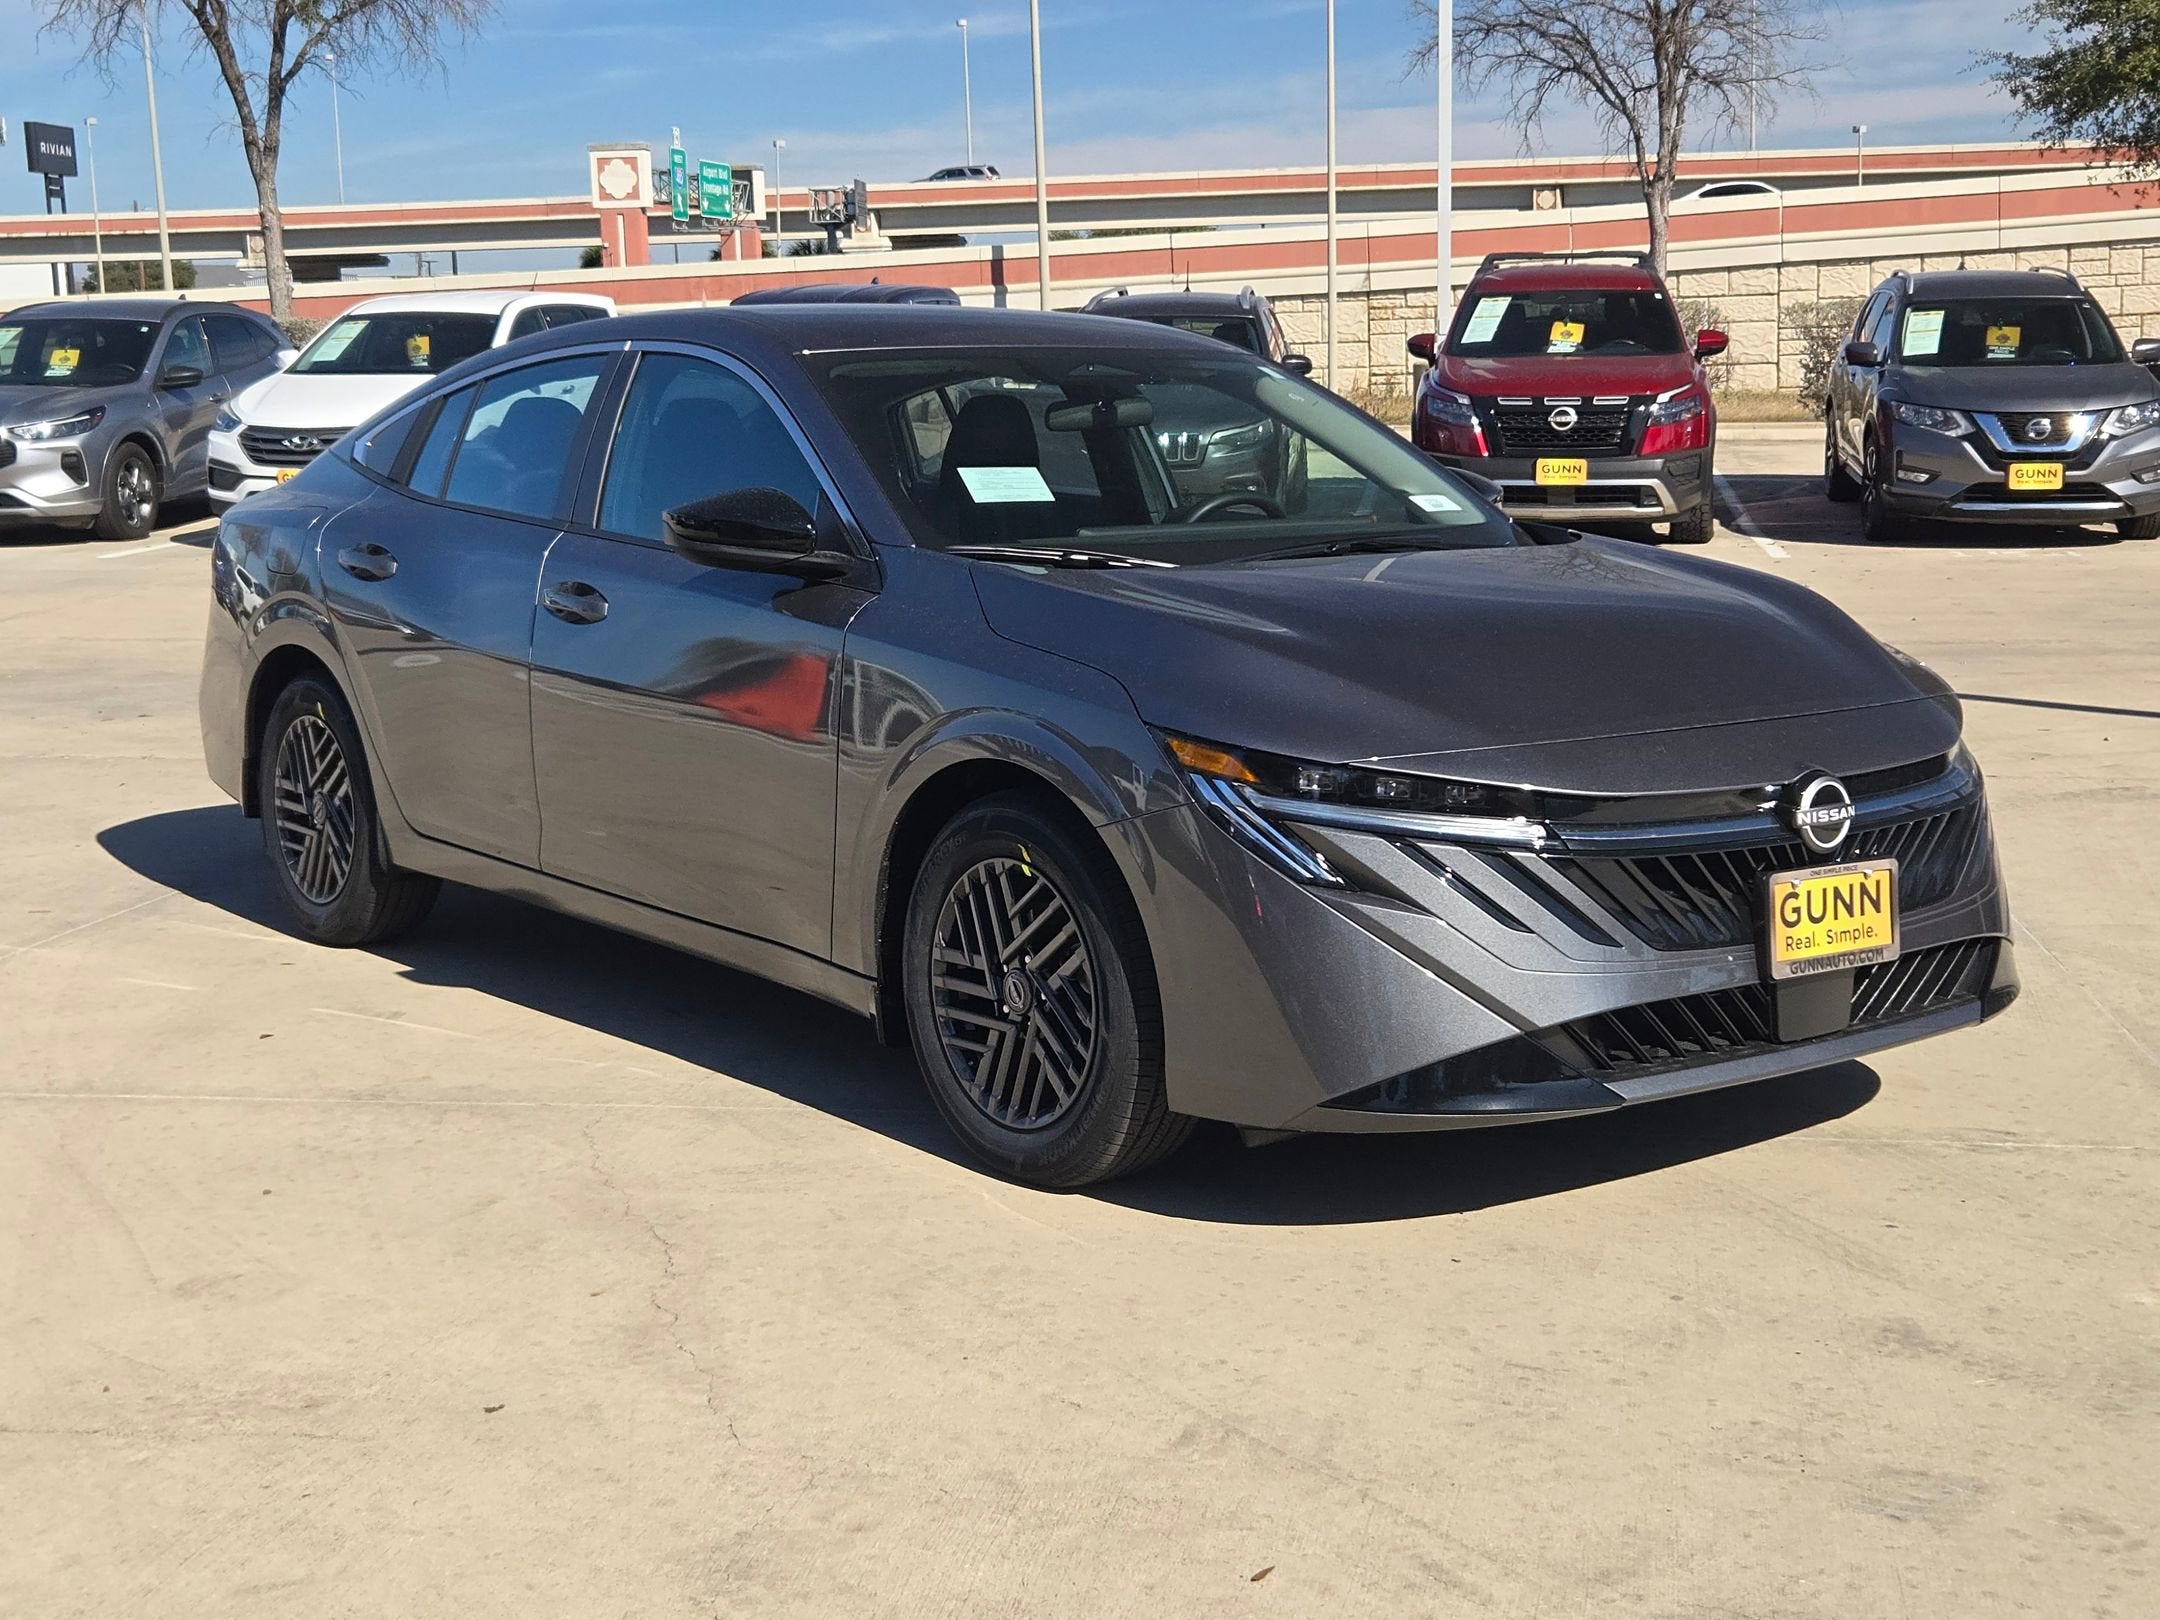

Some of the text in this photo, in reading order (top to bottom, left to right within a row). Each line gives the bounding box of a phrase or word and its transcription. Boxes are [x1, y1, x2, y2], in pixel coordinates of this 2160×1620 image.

[40, 142, 72, 157] RIVIAN
[702, 181, 722, 196] Frontage
[1541, 464, 1582, 475] GUNN
[2015, 469, 2058, 480] GUNN
[1796, 805, 1856, 826] NISSAN
[1809, 864, 1859, 877] ONE SIMPLE PRICE
[1780, 880, 1881, 928] GUNN
[1785, 930, 1820, 952] Real.
[1789, 948, 1884, 975] GUNNAUTO.COM
